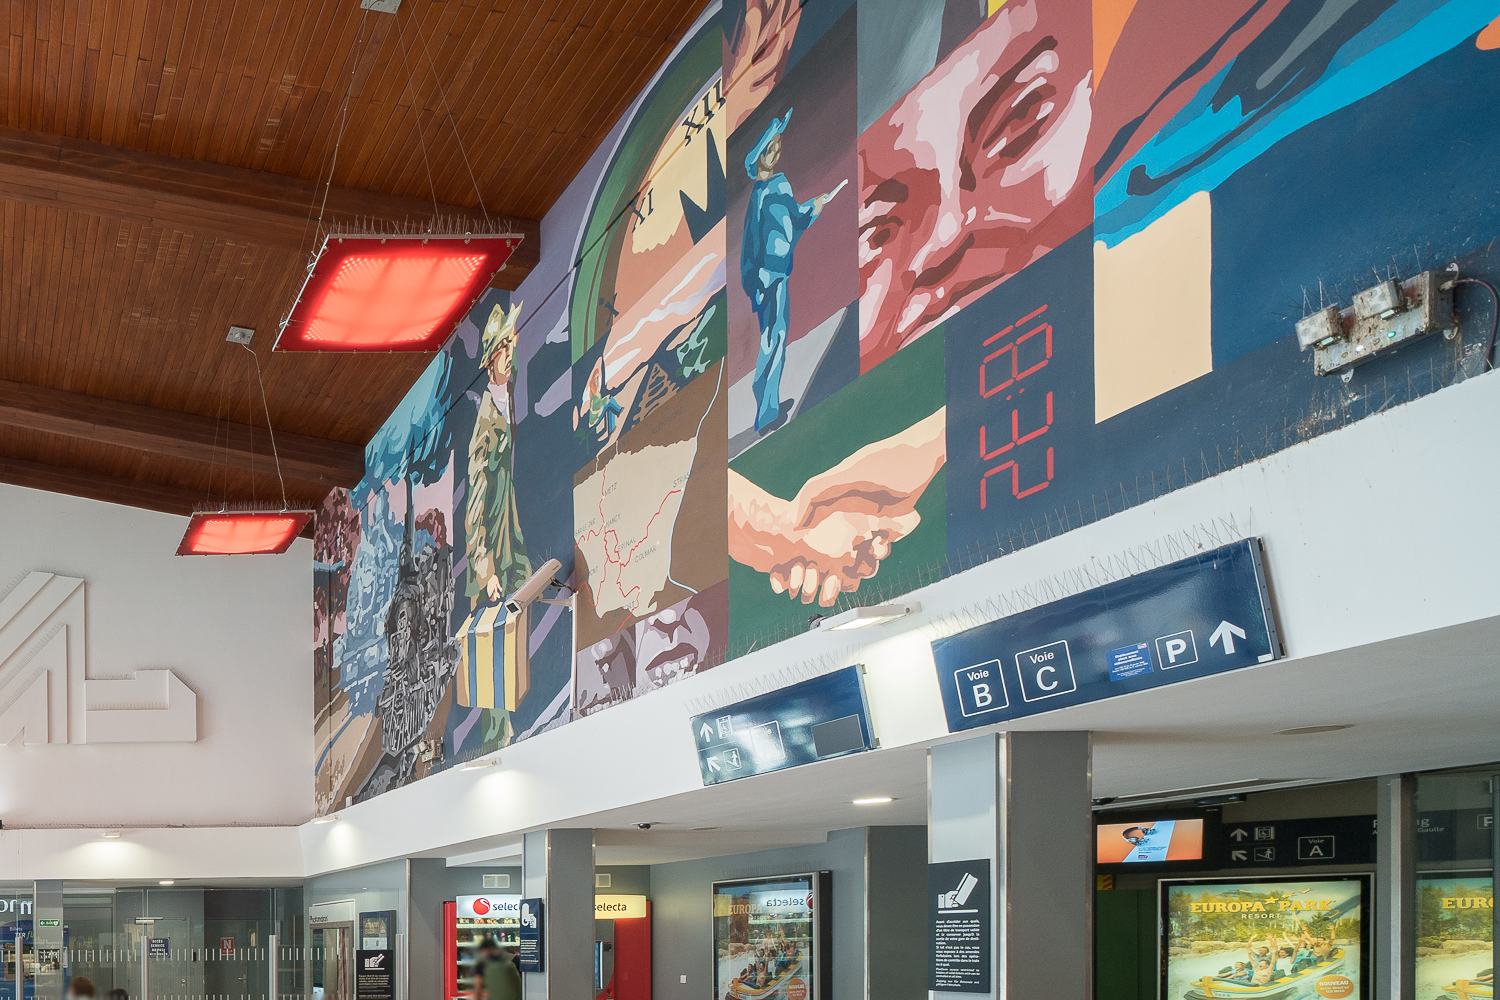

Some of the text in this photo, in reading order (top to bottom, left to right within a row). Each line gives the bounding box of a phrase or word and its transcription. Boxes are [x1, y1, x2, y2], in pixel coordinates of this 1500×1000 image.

[682, 78, 726, 147] XII
[604, 481, 618, 498] METZ
[605, 513, 621, 528] NANCY
[617, 536, 637, 553] EPINAL
[634, 544, 658, 563] COLMAR
[1028, 650, 1055, 665] Voie
[1165, 639, 1187, 663] P
[967, 667, 990, 682] Voie
[1035, 666, 1059, 692] C
[972, 683, 993, 708] B
[1309, 846, 1324, 857] A
[492, 902, 520, 911] selec
[728, 903, 763, 916] EUROPA
[1190, 900, 1334, 914] EUROPA PARK
